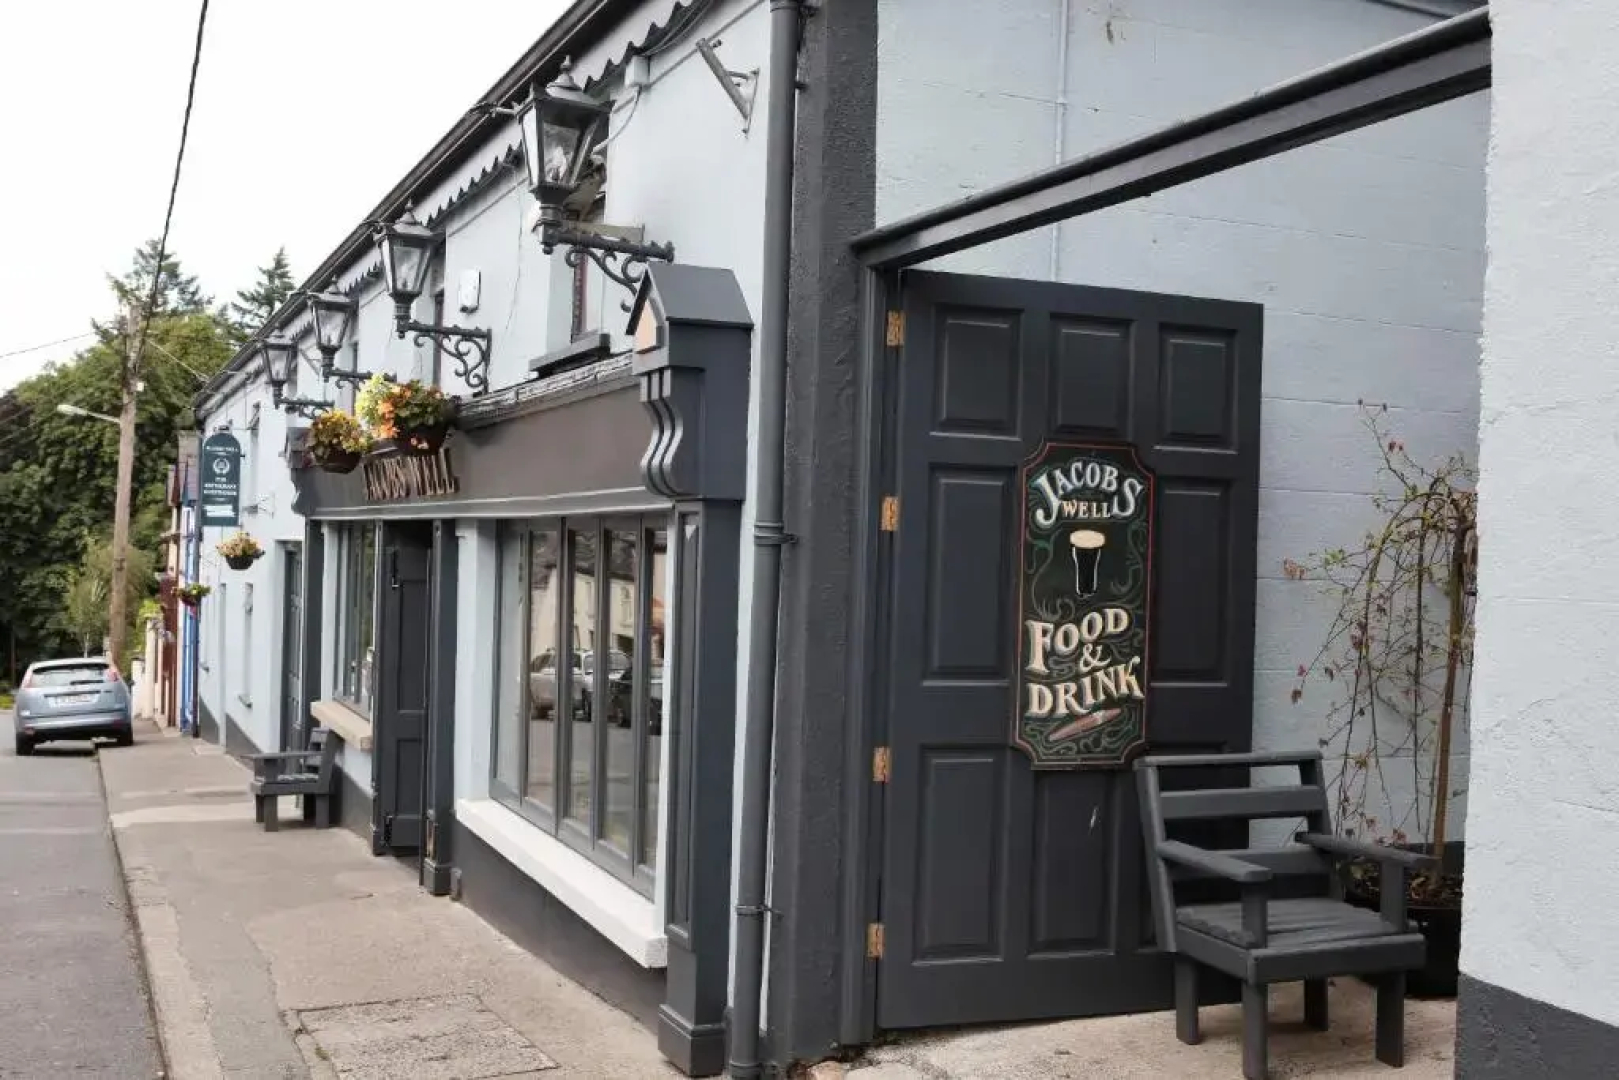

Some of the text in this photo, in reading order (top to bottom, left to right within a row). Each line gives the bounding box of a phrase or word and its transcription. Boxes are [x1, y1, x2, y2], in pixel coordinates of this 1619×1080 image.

[1033, 462, 1143, 528] JACOBS
[1061, 499, 1111, 518] WELL
[1025, 608, 1129, 675] FOOD
[1079, 643, 1111, 674] &
[1024, 656, 1145, 718] DRINK
